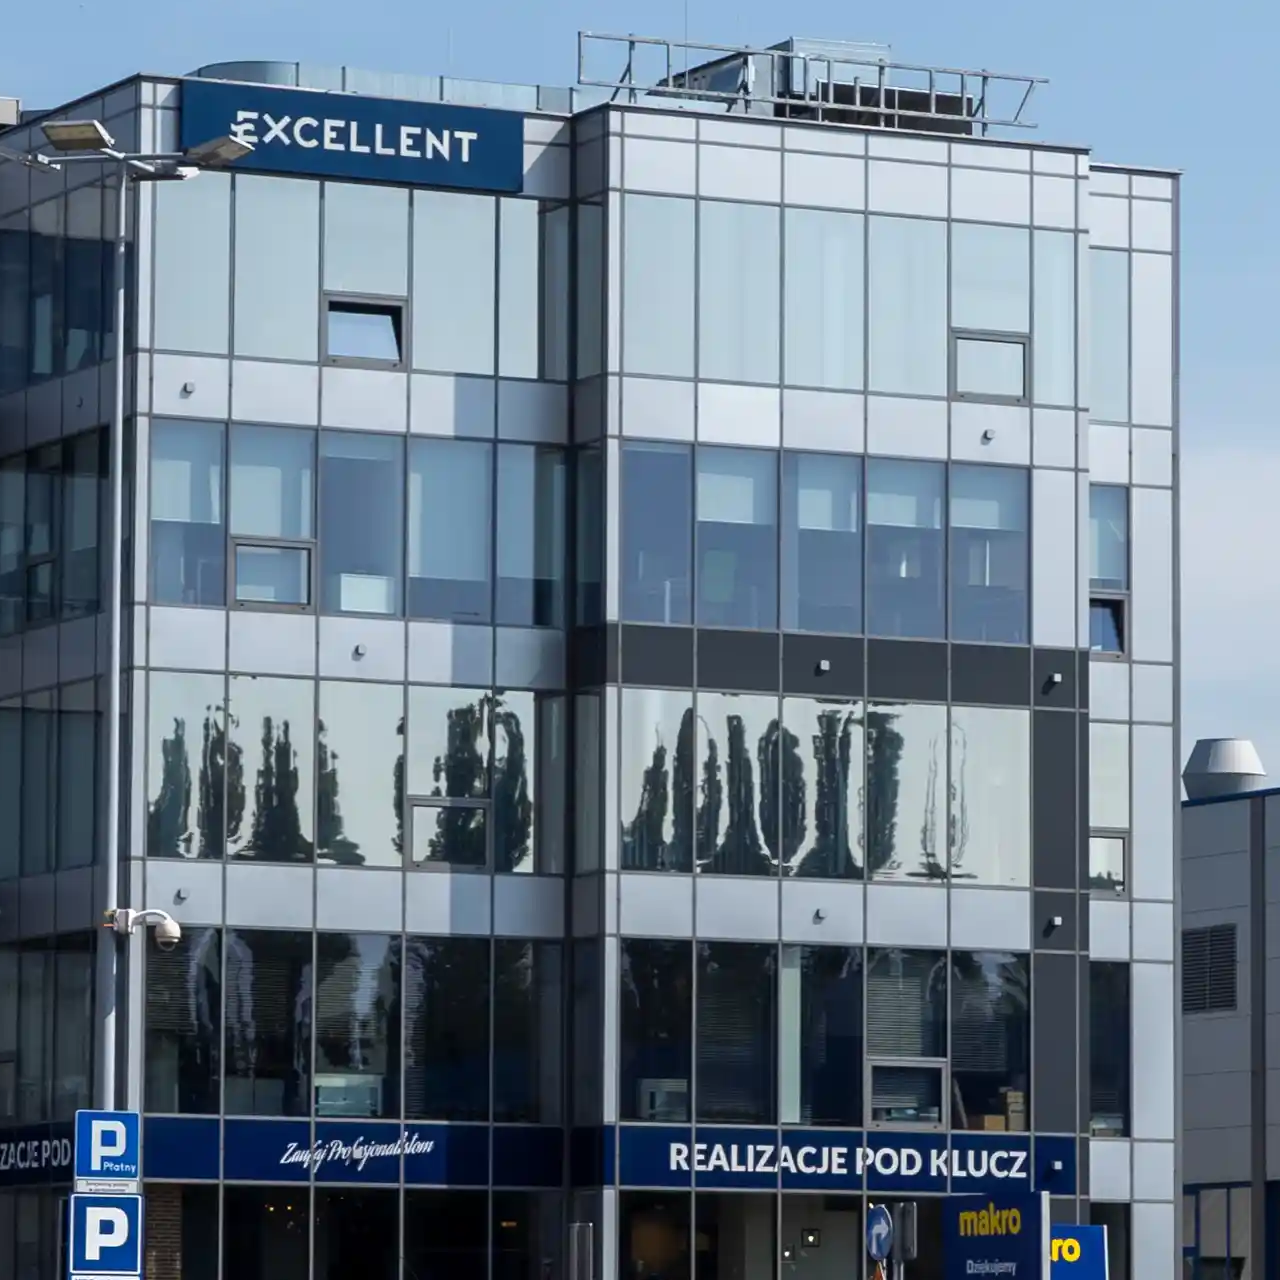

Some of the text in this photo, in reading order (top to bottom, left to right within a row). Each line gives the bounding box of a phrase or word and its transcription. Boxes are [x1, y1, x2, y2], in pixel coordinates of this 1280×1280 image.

[229, 110, 478, 162] EXCELLENT
[41, 1138, 71, 1168] POD
[91, 1119, 127, 1171] P
[327, 1131, 435, 1172] Profsjonalstom
[669, 1143, 1028, 1179] REALIZACJE POD KLUCZ
[103, 1161, 136, 1174] Płatny
[85, 1206, 129, 1261] P
[959, 1202, 1021, 1236] makro
[1048, 1238, 1081, 1262] ro
